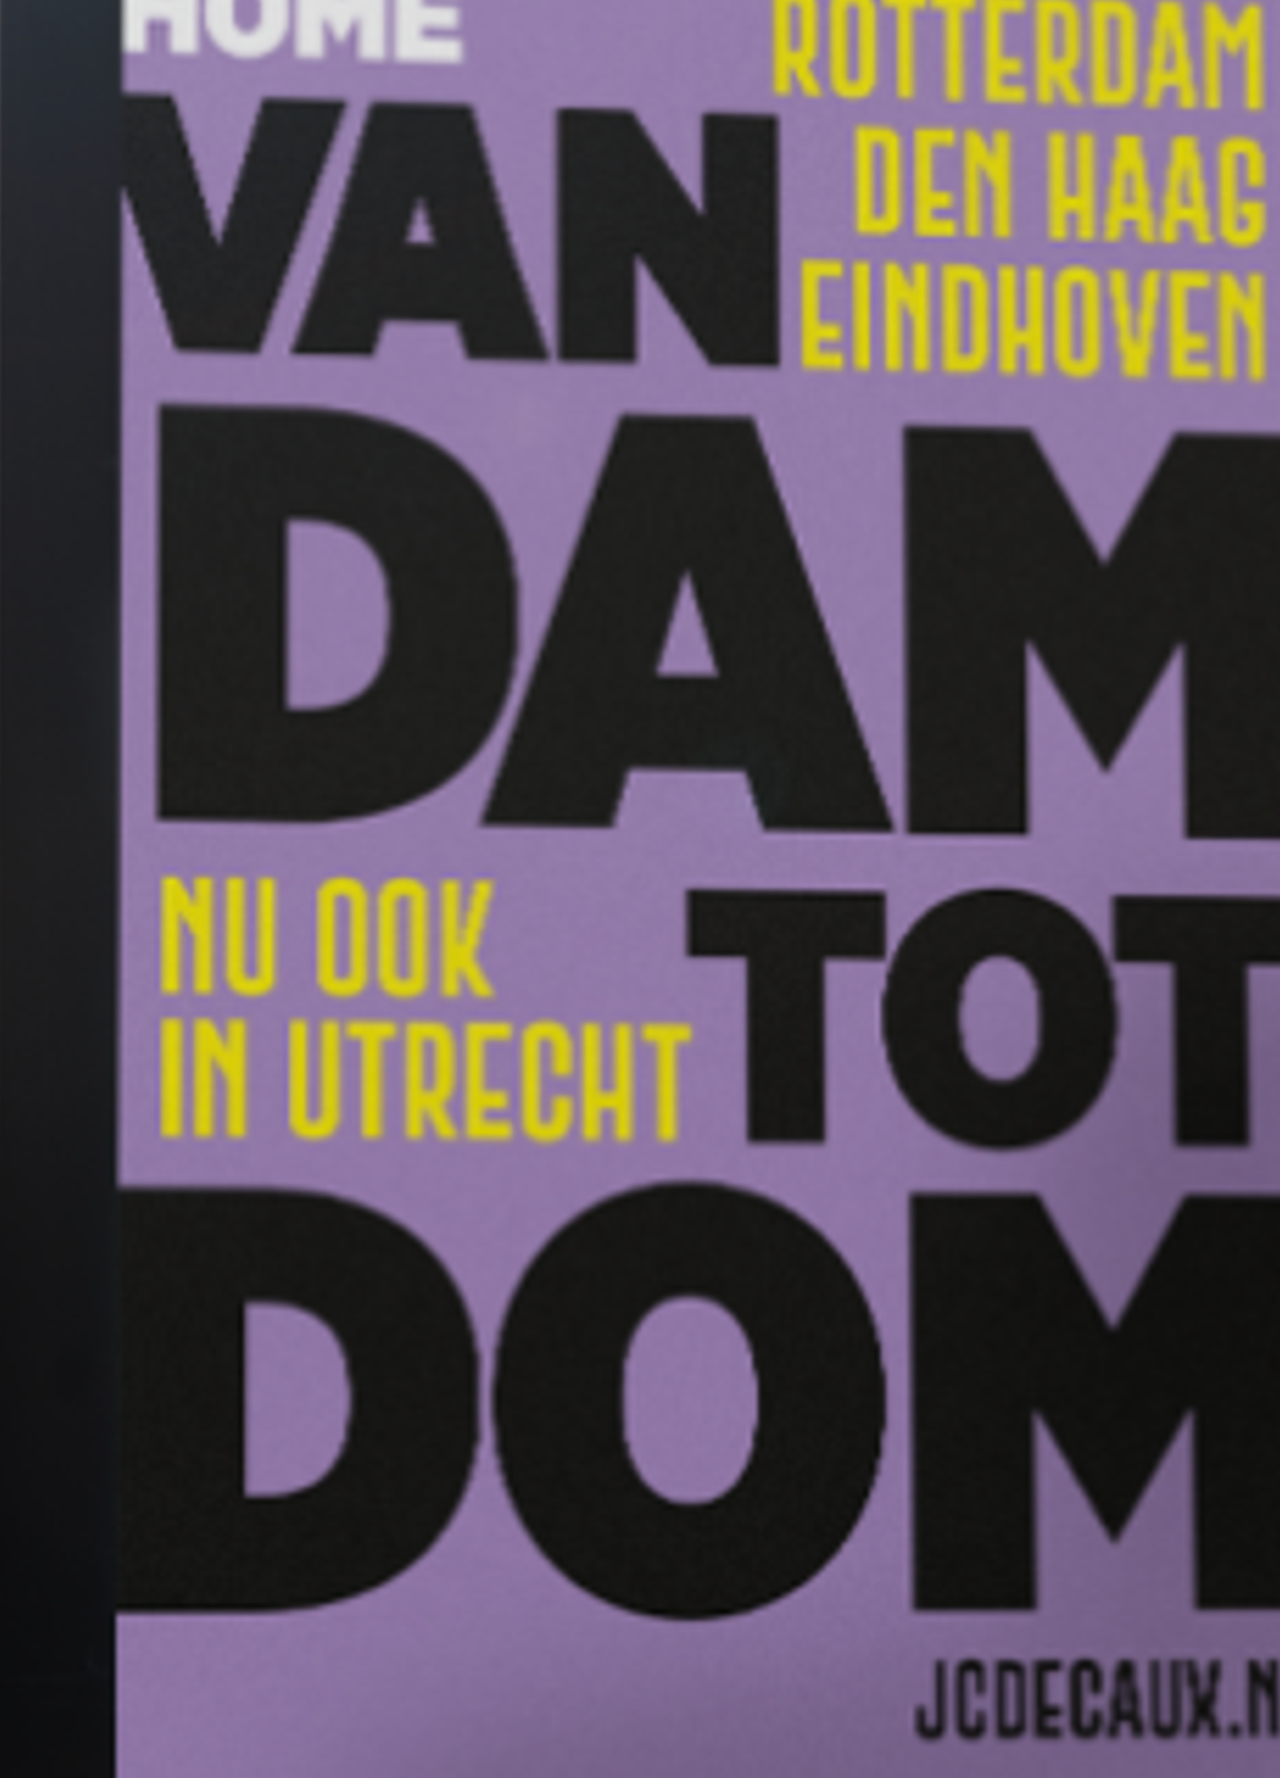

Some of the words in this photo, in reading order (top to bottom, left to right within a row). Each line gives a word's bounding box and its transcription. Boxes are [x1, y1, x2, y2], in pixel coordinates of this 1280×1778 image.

[122, 94, 781, 368] VAN
[854, 124, 1013, 239] DEN
[1047, 130, 1267, 248] HAAG
[801, 258, 1267, 382] EINDHOVEN
[160, 875, 277, 997] NU
[317, 876, 495, 999] OOK
[160, 1017, 248, 1138] IN
[289, 1018, 693, 1143] UTRECHT
